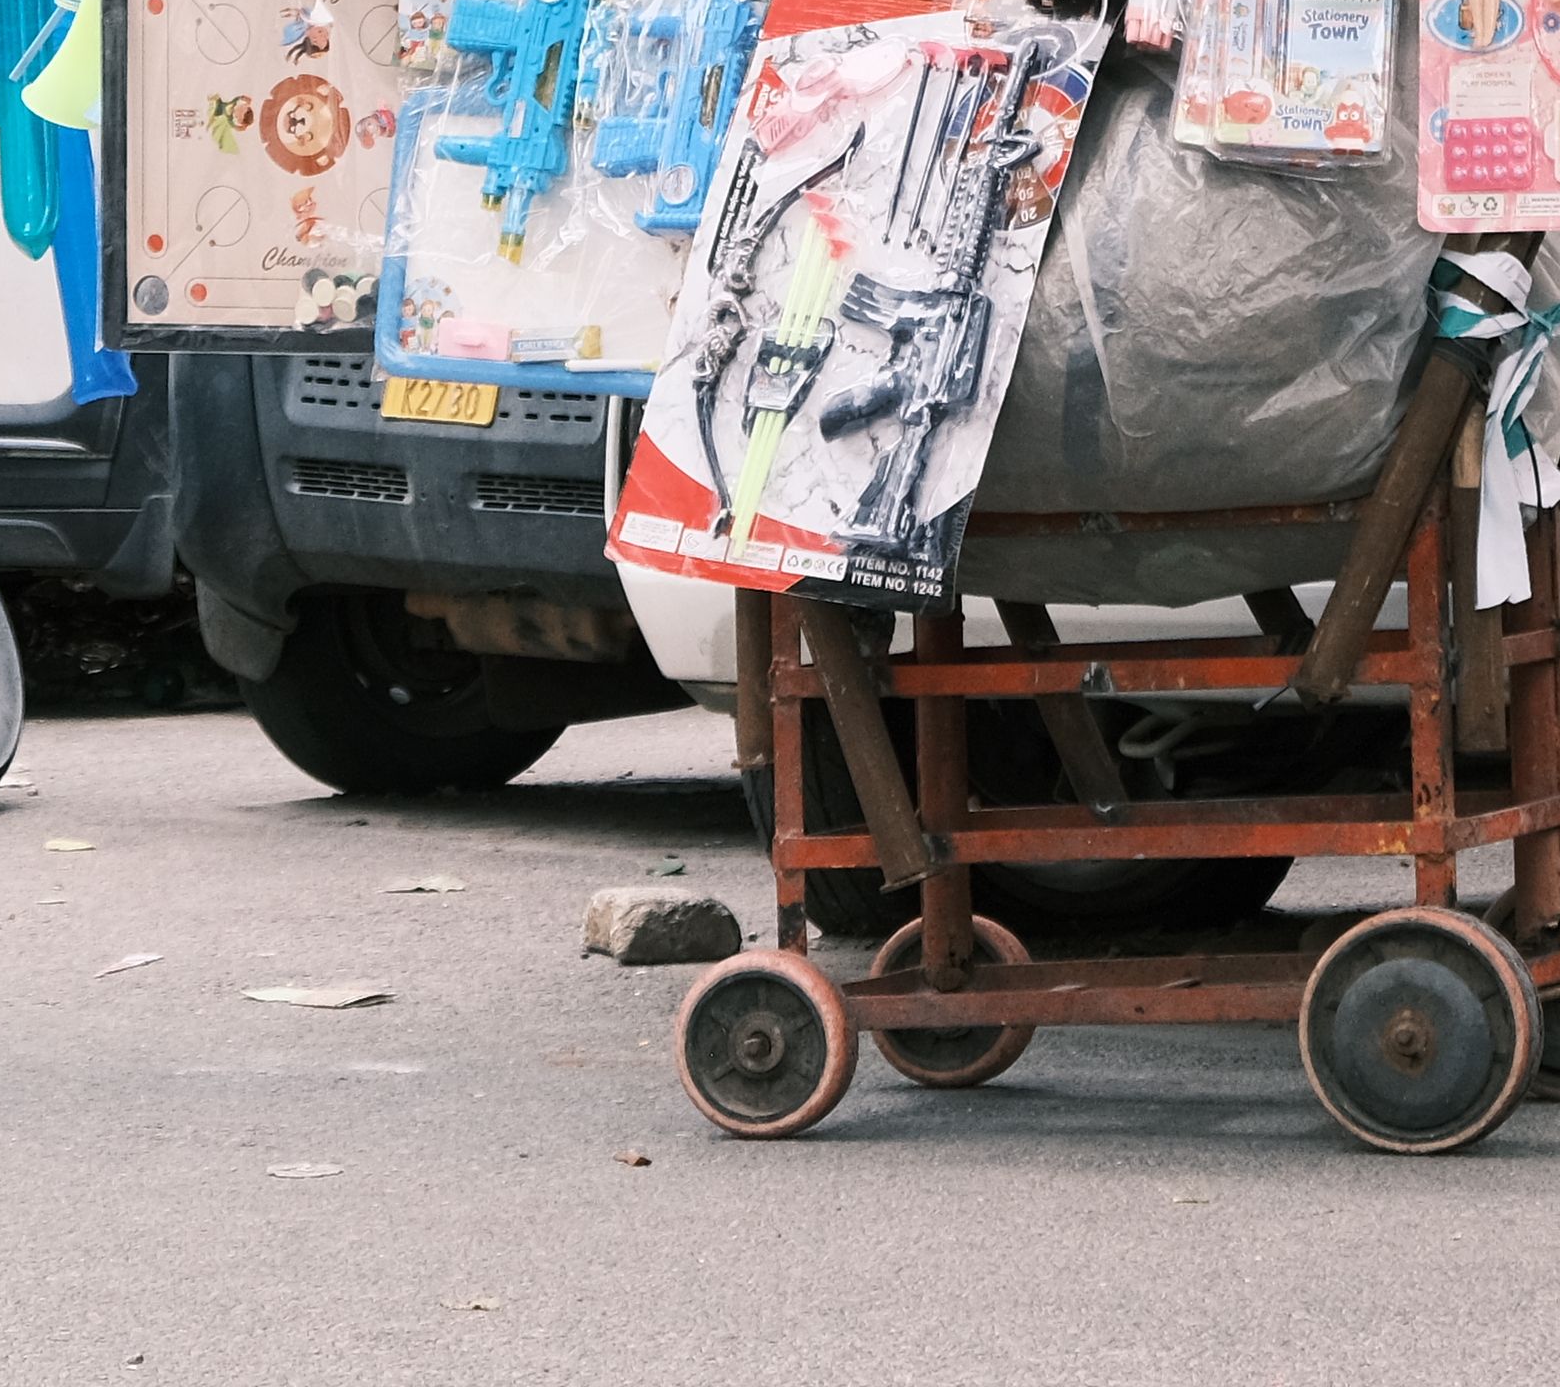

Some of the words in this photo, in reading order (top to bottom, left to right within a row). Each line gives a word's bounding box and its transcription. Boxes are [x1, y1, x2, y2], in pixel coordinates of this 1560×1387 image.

[1302, 9, 1370, 30] Stationery
[1308, 24, 1360, 41] Town
[1275, 104, 1333, 124] Stationery
[1282, 117, 1323, 129] Town
[855, 556, 885, 572] ITEM
[887, 559, 912, 576] NO.
[915, 564, 943, 581] 1142
[851, 571, 882, 587] ITEM
[884, 575, 908, 592] NO.
[913, 580, 943, 598] 1242
